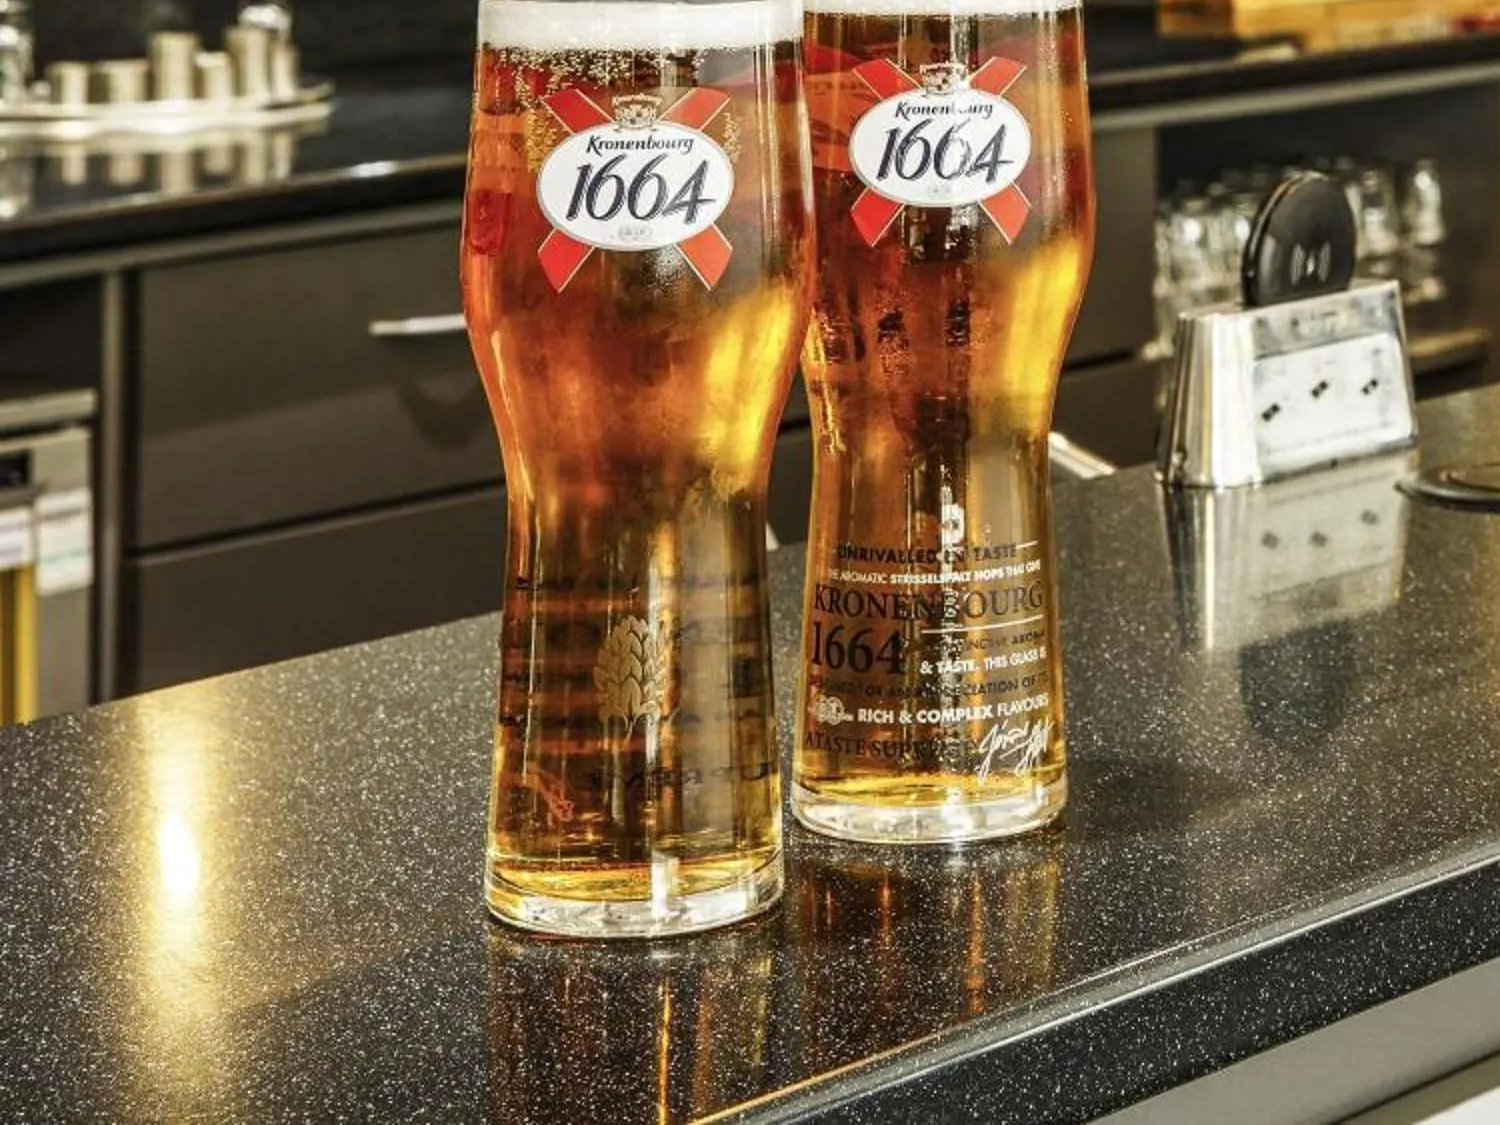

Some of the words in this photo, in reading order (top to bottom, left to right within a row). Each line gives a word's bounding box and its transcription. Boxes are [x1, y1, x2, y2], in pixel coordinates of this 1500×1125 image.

[894, 101, 994, 122] Kronenurg
[586, 134, 695, 156] Kronenbourg
[875, 118, 1014, 185] 1664
[565, 153, 717, 225] 1664
[973, 566, 1004, 582] HOPS
[811, 621, 907, 676] 1664
[920, 660, 933, 675] &
[984, 654, 1008, 671] THIS
[857, 708, 895, 724] RICH
[899, 709, 913, 724] &
[915, 705, 994, 724] COMPLEX
